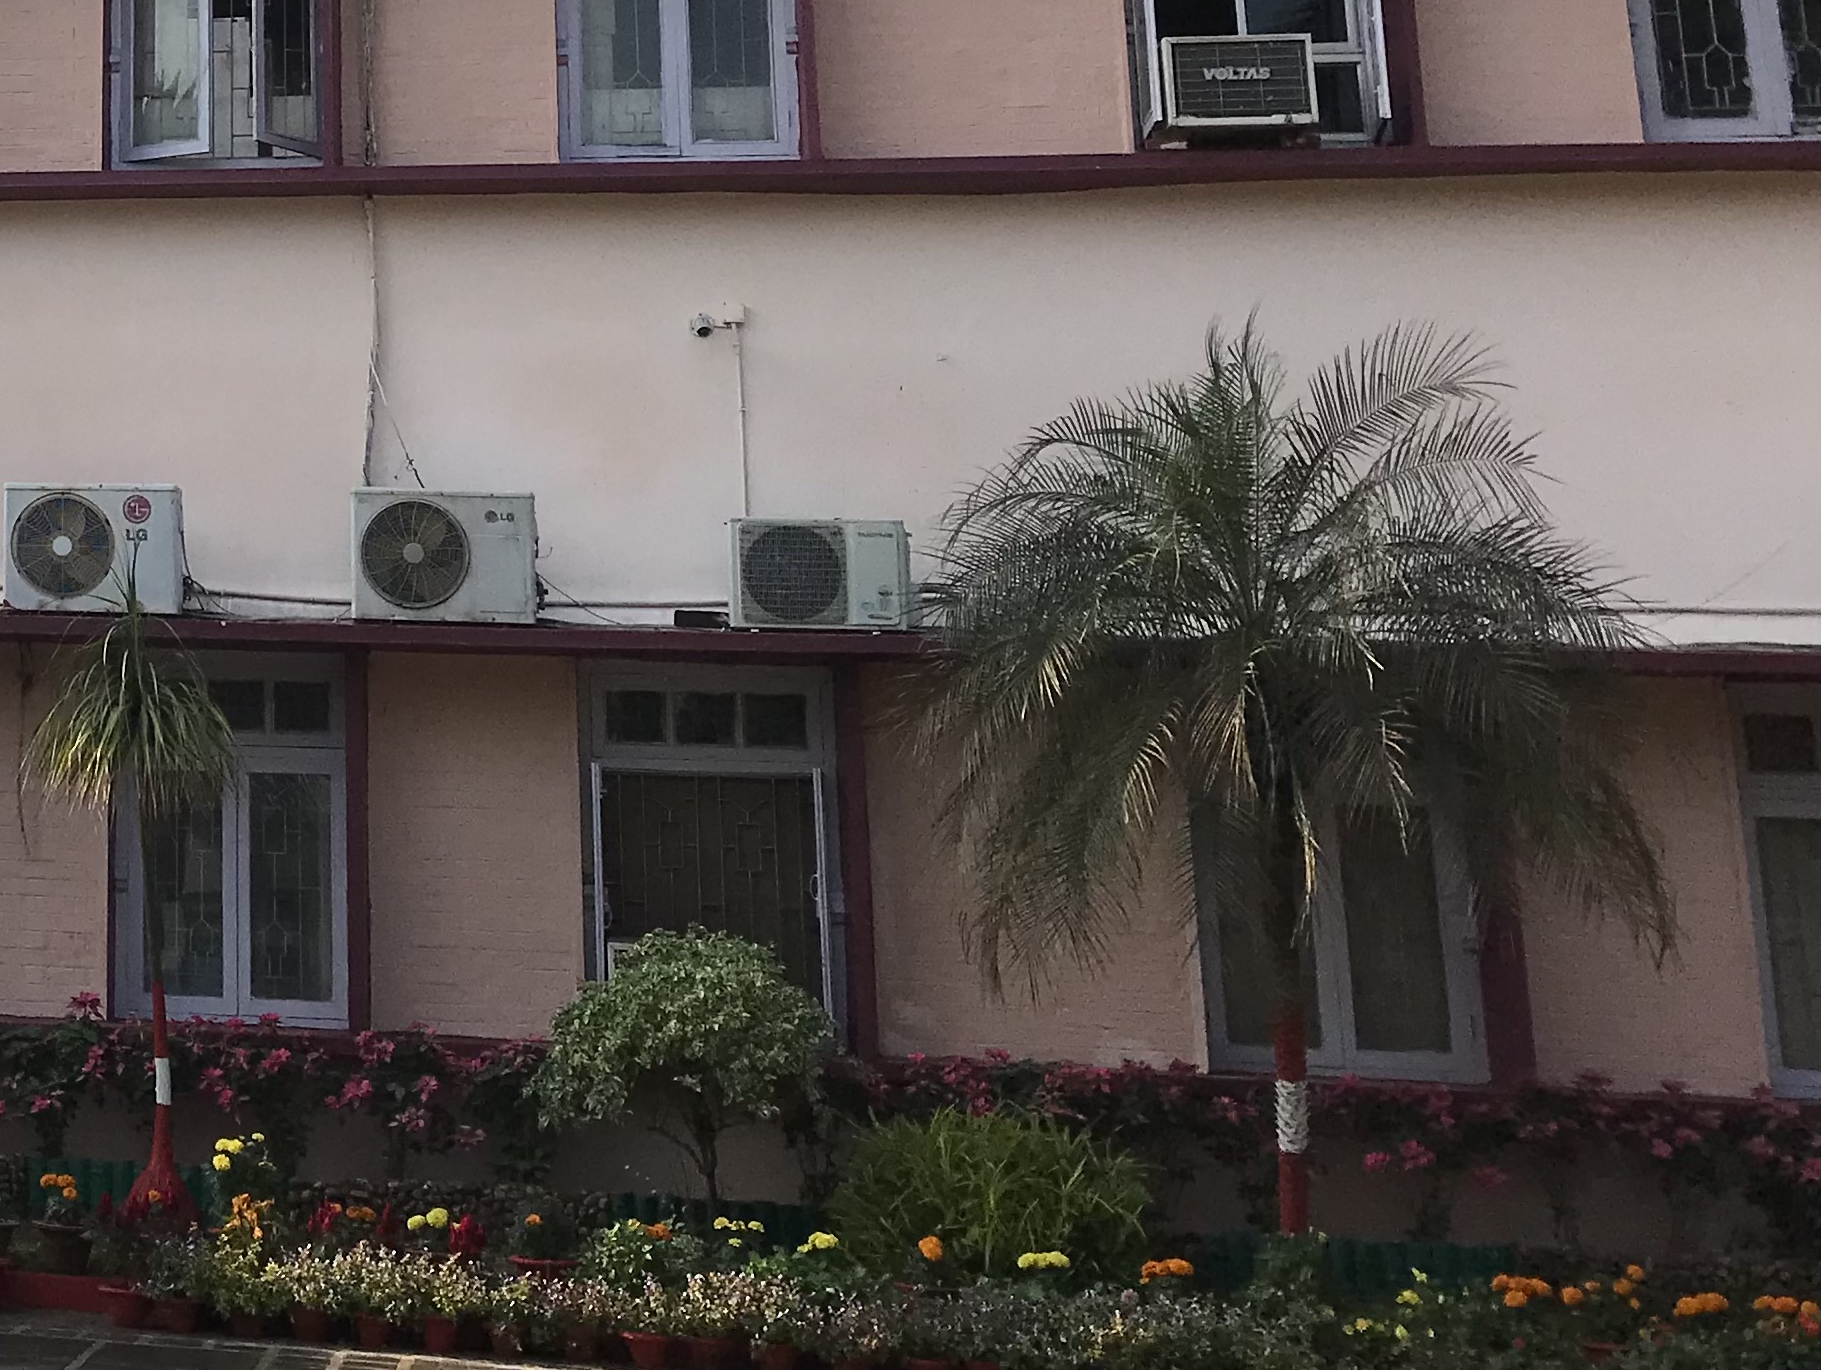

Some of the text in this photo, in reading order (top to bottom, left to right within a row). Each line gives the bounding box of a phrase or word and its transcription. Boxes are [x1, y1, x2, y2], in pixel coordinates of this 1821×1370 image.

[1203, 66, 1272, 81] VOLTAS
[499, 512, 515, 522] LG
[125, 528, 148, 541] LG
